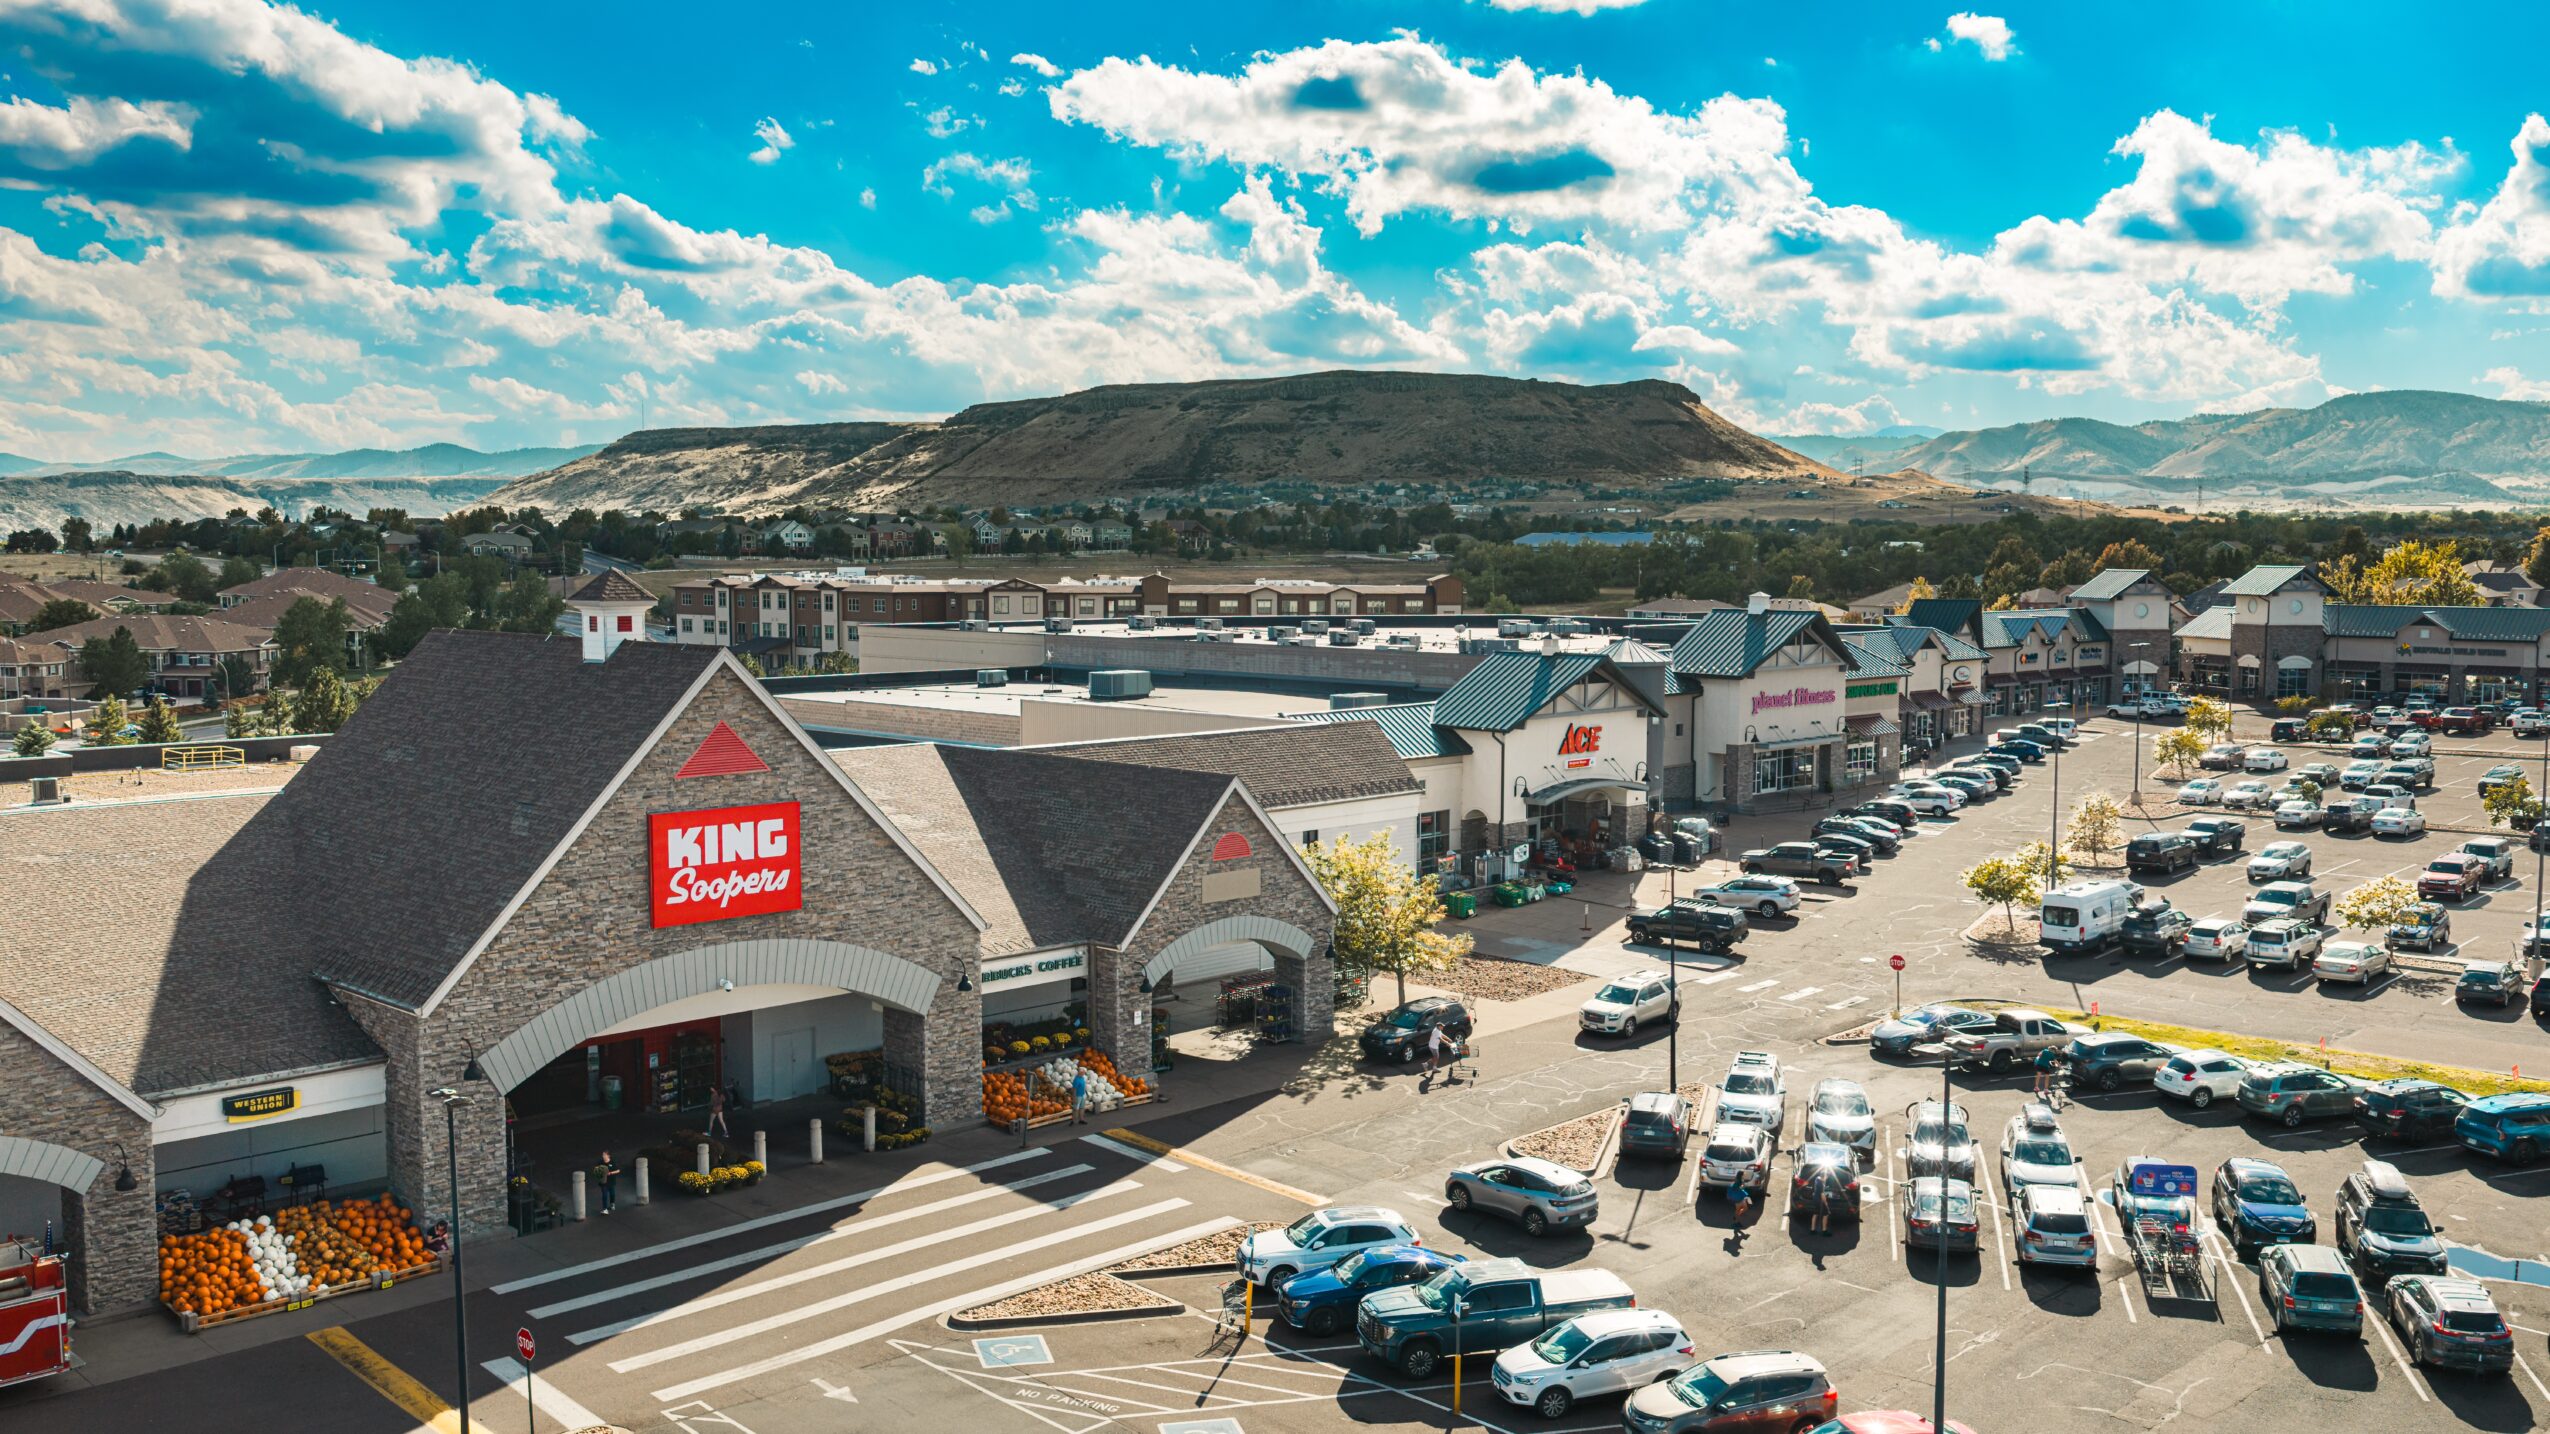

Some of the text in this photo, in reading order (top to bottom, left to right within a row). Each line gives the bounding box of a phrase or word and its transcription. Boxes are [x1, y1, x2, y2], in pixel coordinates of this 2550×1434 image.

[1751, 687, 1836, 715] planet fitness
[1558, 722, 1602, 755] ACE
[667, 818, 788, 869] KING
[665, 866, 791, 908] Soopers
[981, 956, 1083, 983] RBUCKS COFFEE
[1890, 959, 1905, 967] STOP
[234, 1094, 283, 1109] WESTERN
[249, 1100, 283, 1112] UNION
[518, 1335, 534, 1352] STOP
[1015, 1388, 1121, 1413] NO PARKING
